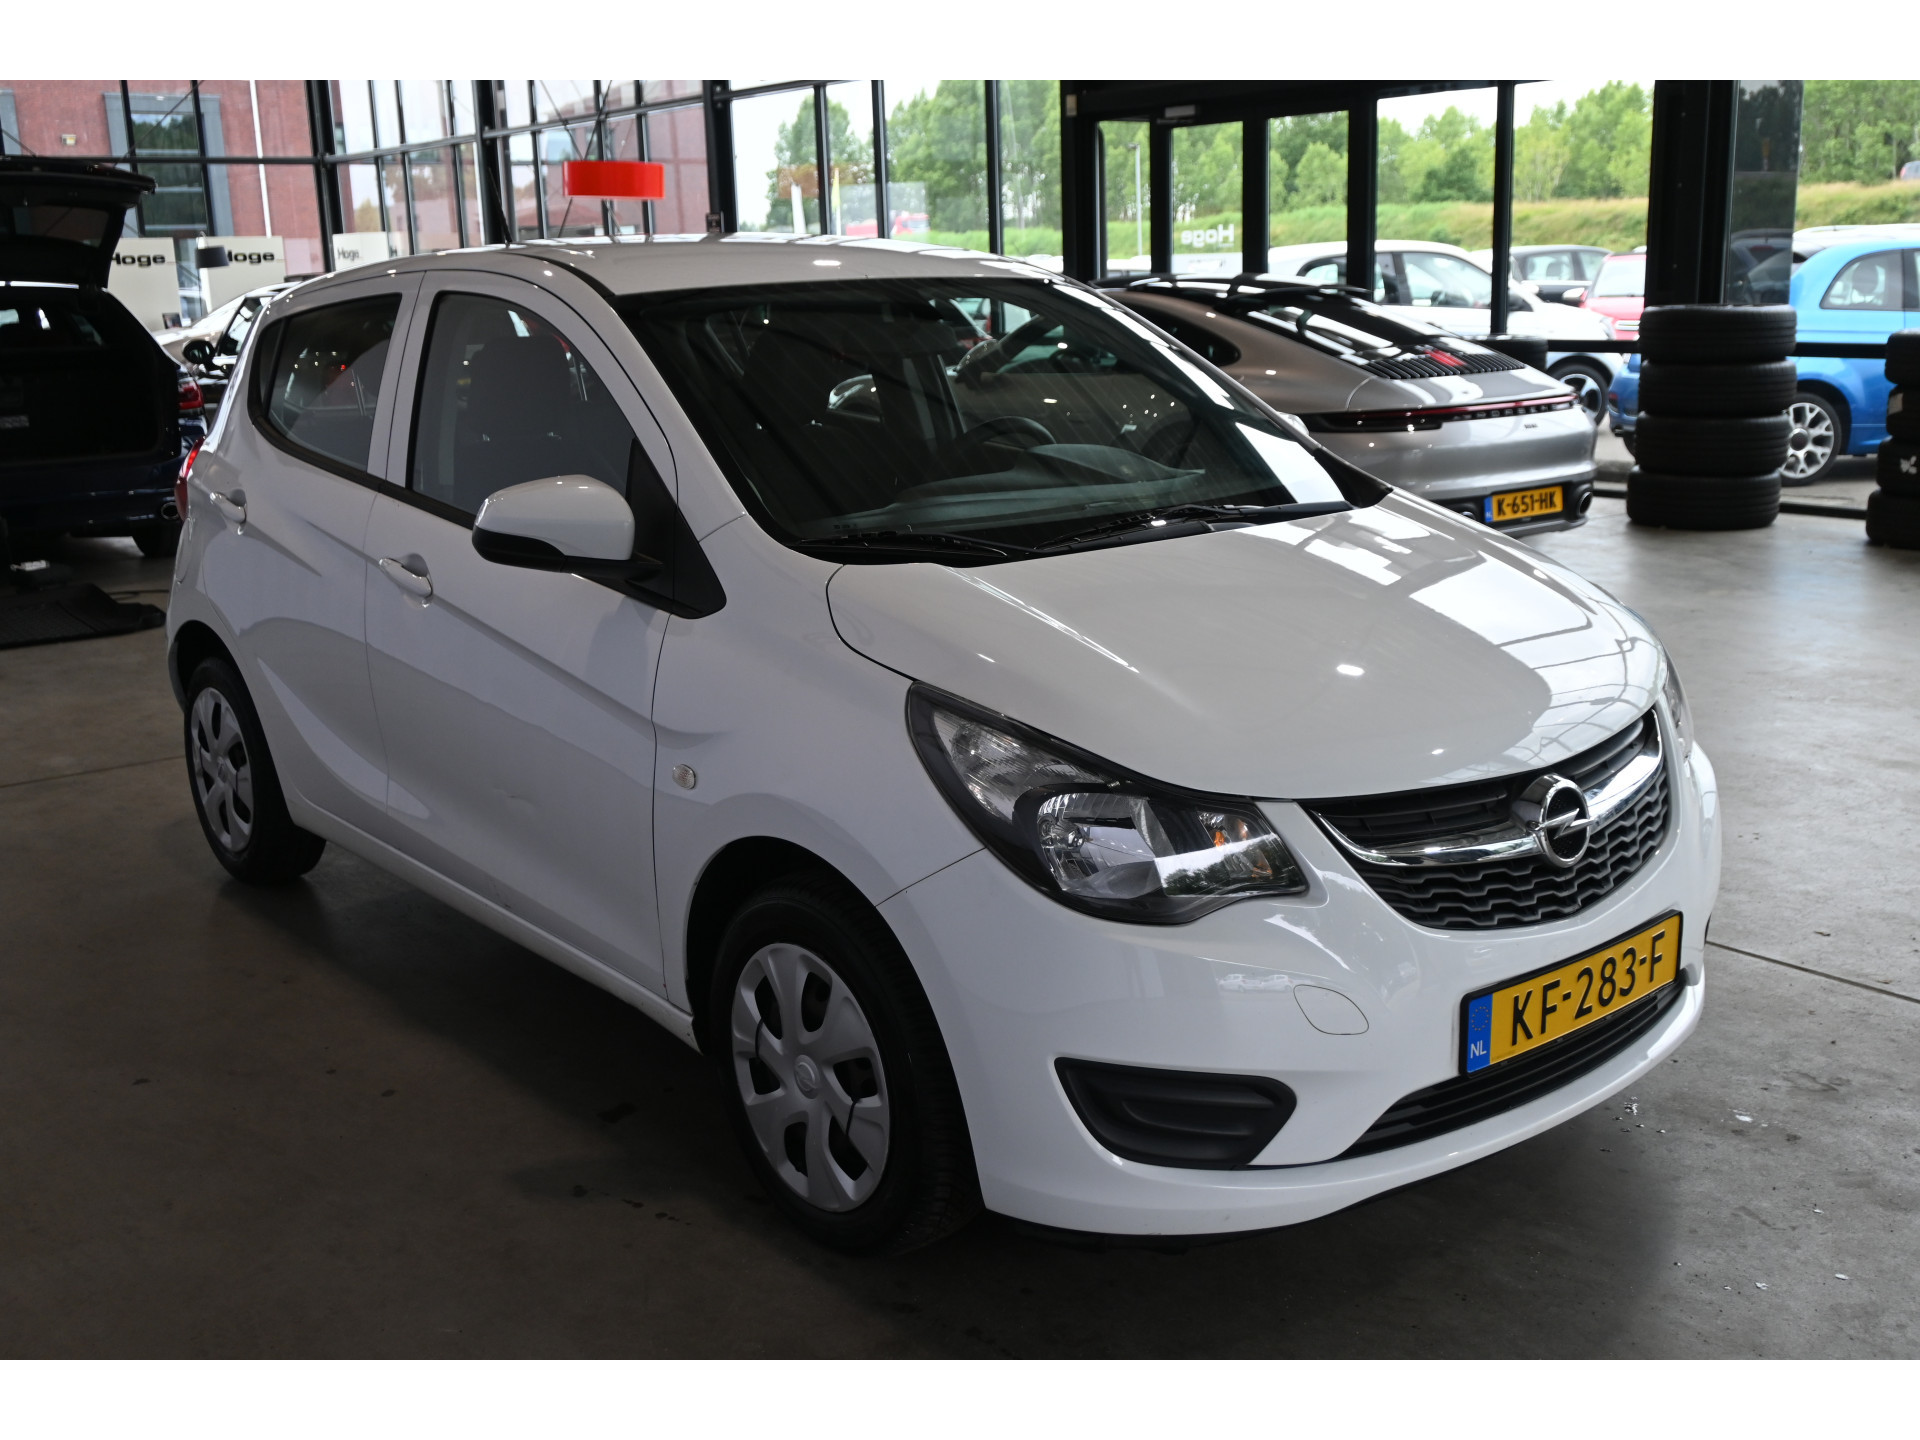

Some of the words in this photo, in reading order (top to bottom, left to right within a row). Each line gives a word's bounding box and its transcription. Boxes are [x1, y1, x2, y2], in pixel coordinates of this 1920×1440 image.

[1497, 490, 1557, 517] K-651-HK
[1511, 929, 1666, 1047] KF-283-F
[1469, 1040, 1488, 1060] NL
